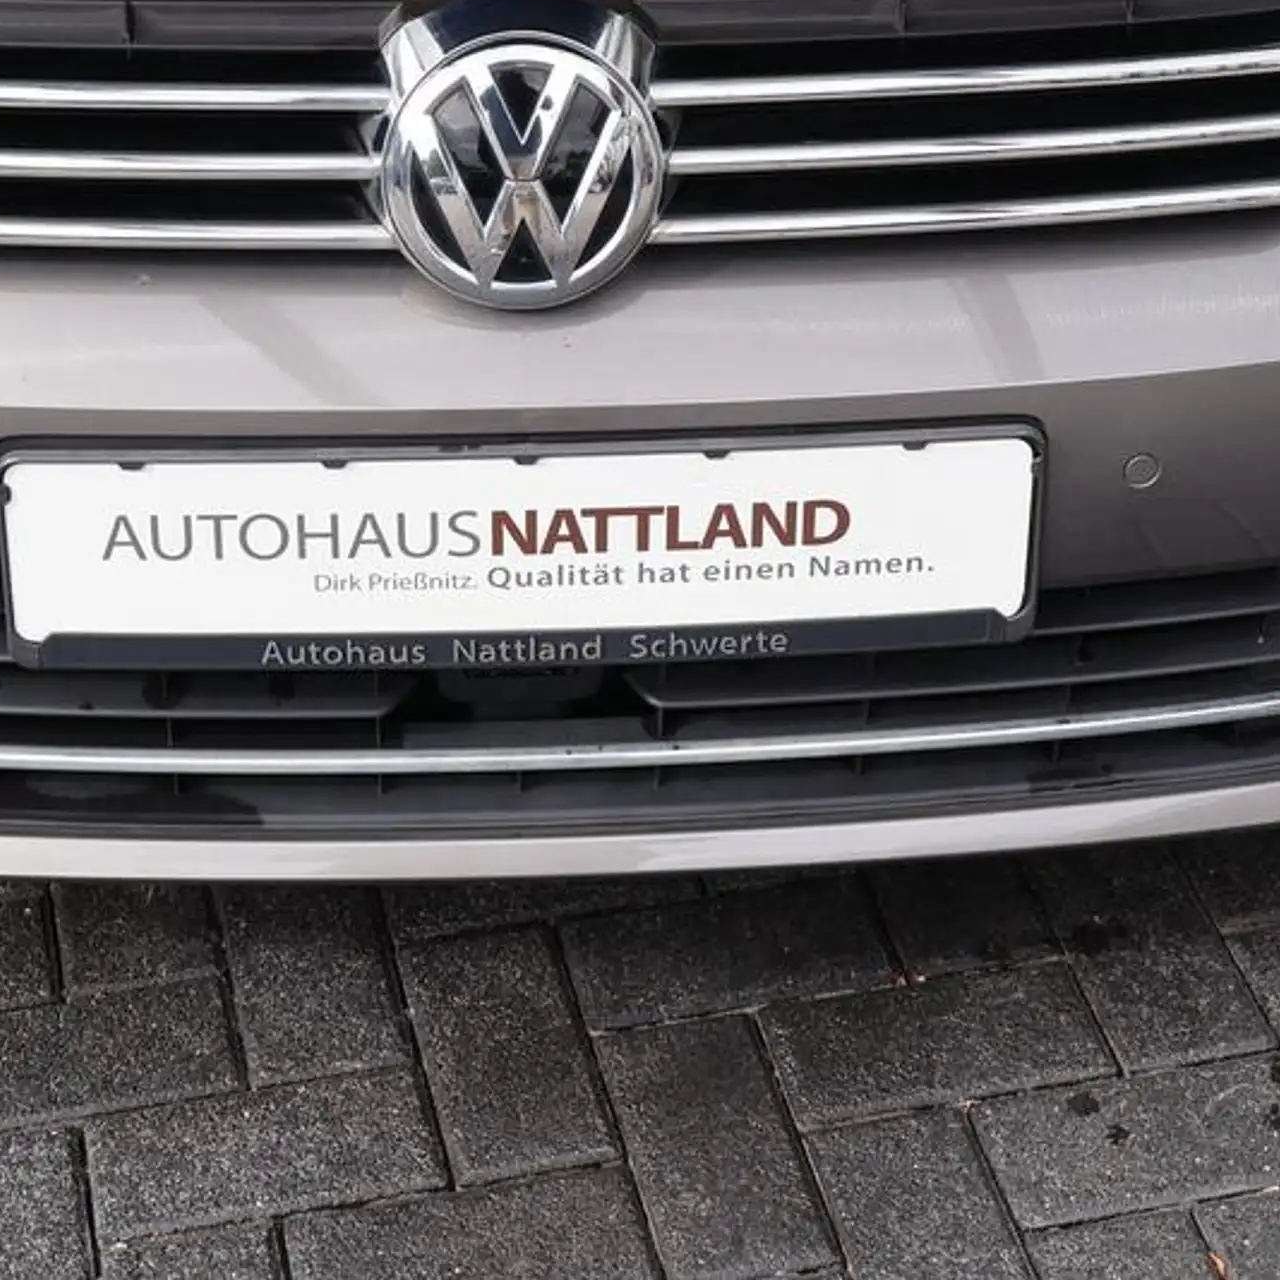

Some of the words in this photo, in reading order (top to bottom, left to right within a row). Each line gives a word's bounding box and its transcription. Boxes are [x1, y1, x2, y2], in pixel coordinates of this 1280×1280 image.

[314, 573, 362, 592] Dirk
[487, 562, 623, 592] Qualität
[637, 561, 691, 584] hat
[702, 559, 795, 582] einen
[809, 555, 934, 578] Namen.
[261, 639, 425, 666] Autohaus
[452, 634, 602, 663] Nattland
[629, 631, 787, 659] Schwerte
